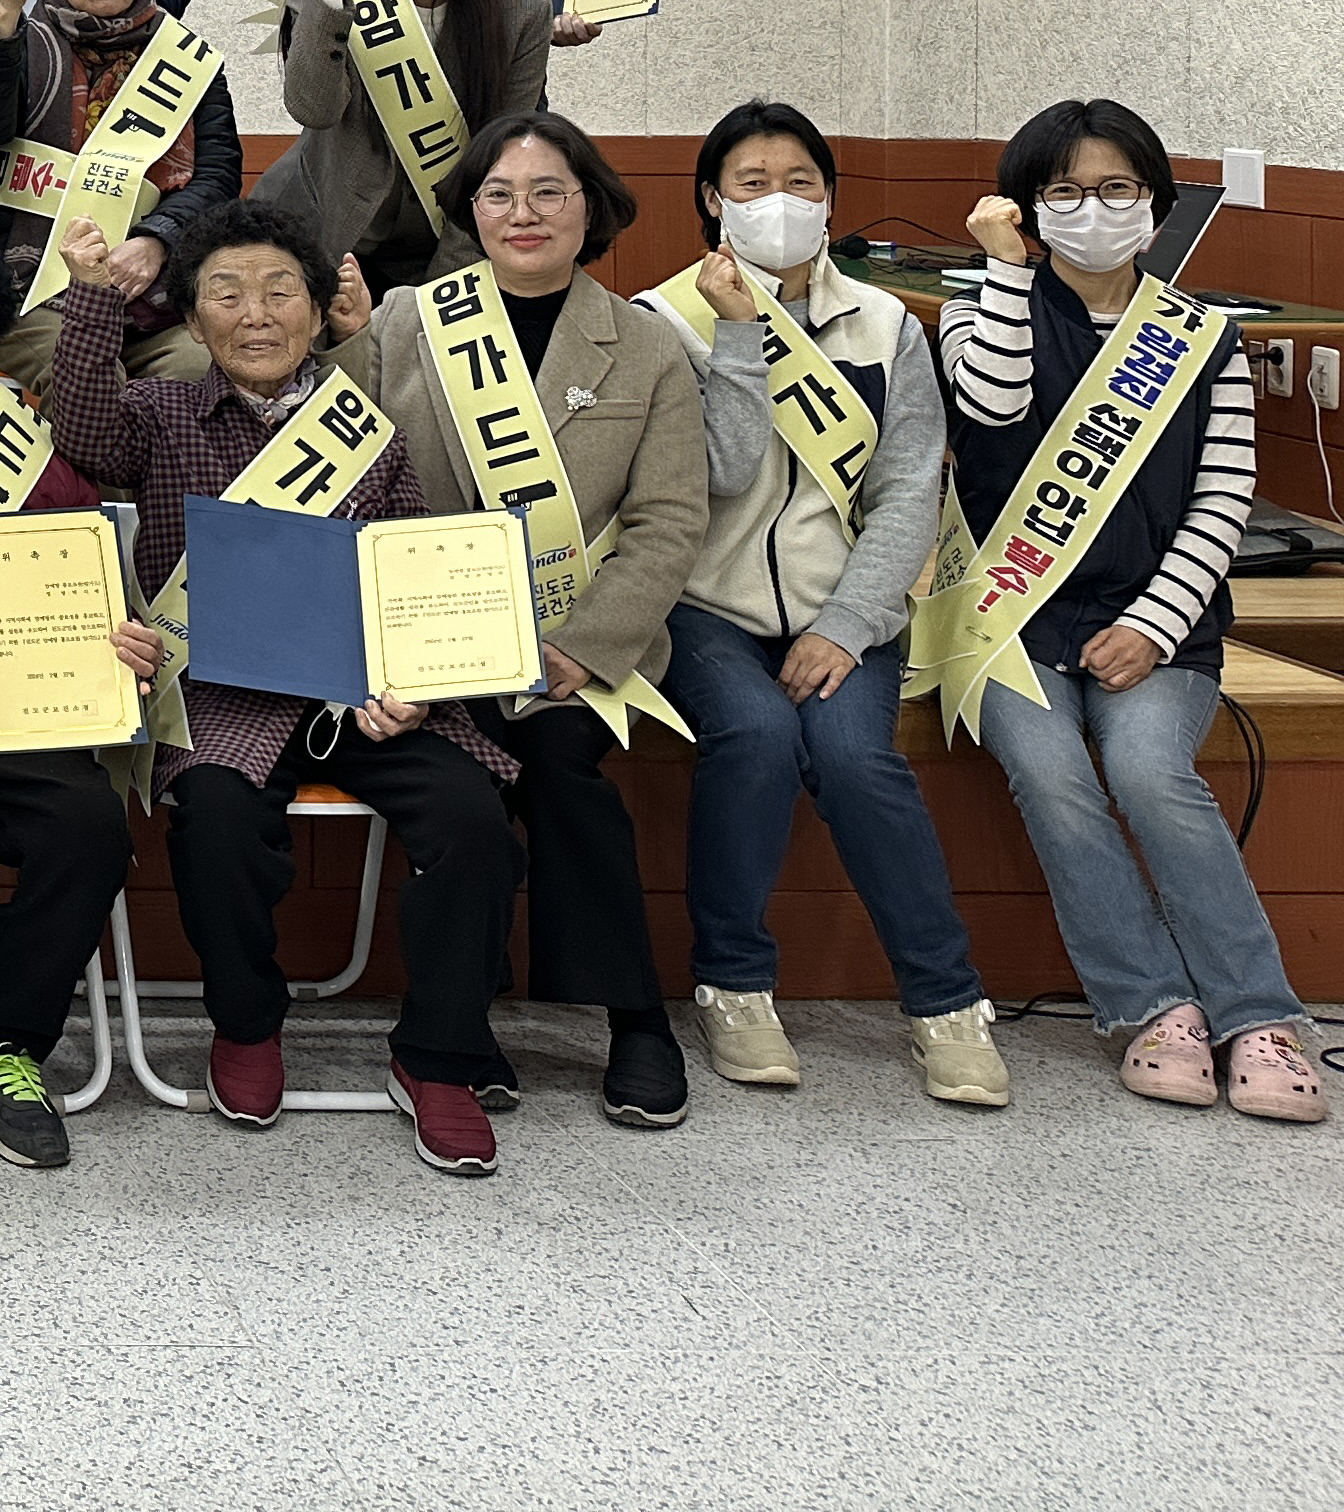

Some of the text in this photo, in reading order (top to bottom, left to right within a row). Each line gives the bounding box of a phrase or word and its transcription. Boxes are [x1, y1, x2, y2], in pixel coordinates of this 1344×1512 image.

[81, 177, 124, 198] 보건소
[88, 161, 129, 182] 진도군
[432, 271, 541, 471] 암가드
[1107, 321, 1191, 411] 암검진
[272, 389, 379, 507] 암가
[1056, 402, 1143, 491] 선택이
[1023, 480, 1087, 547] 아닌
[532, 548, 568, 570] ndo
[976, 534, 1056, 614] 필수!
